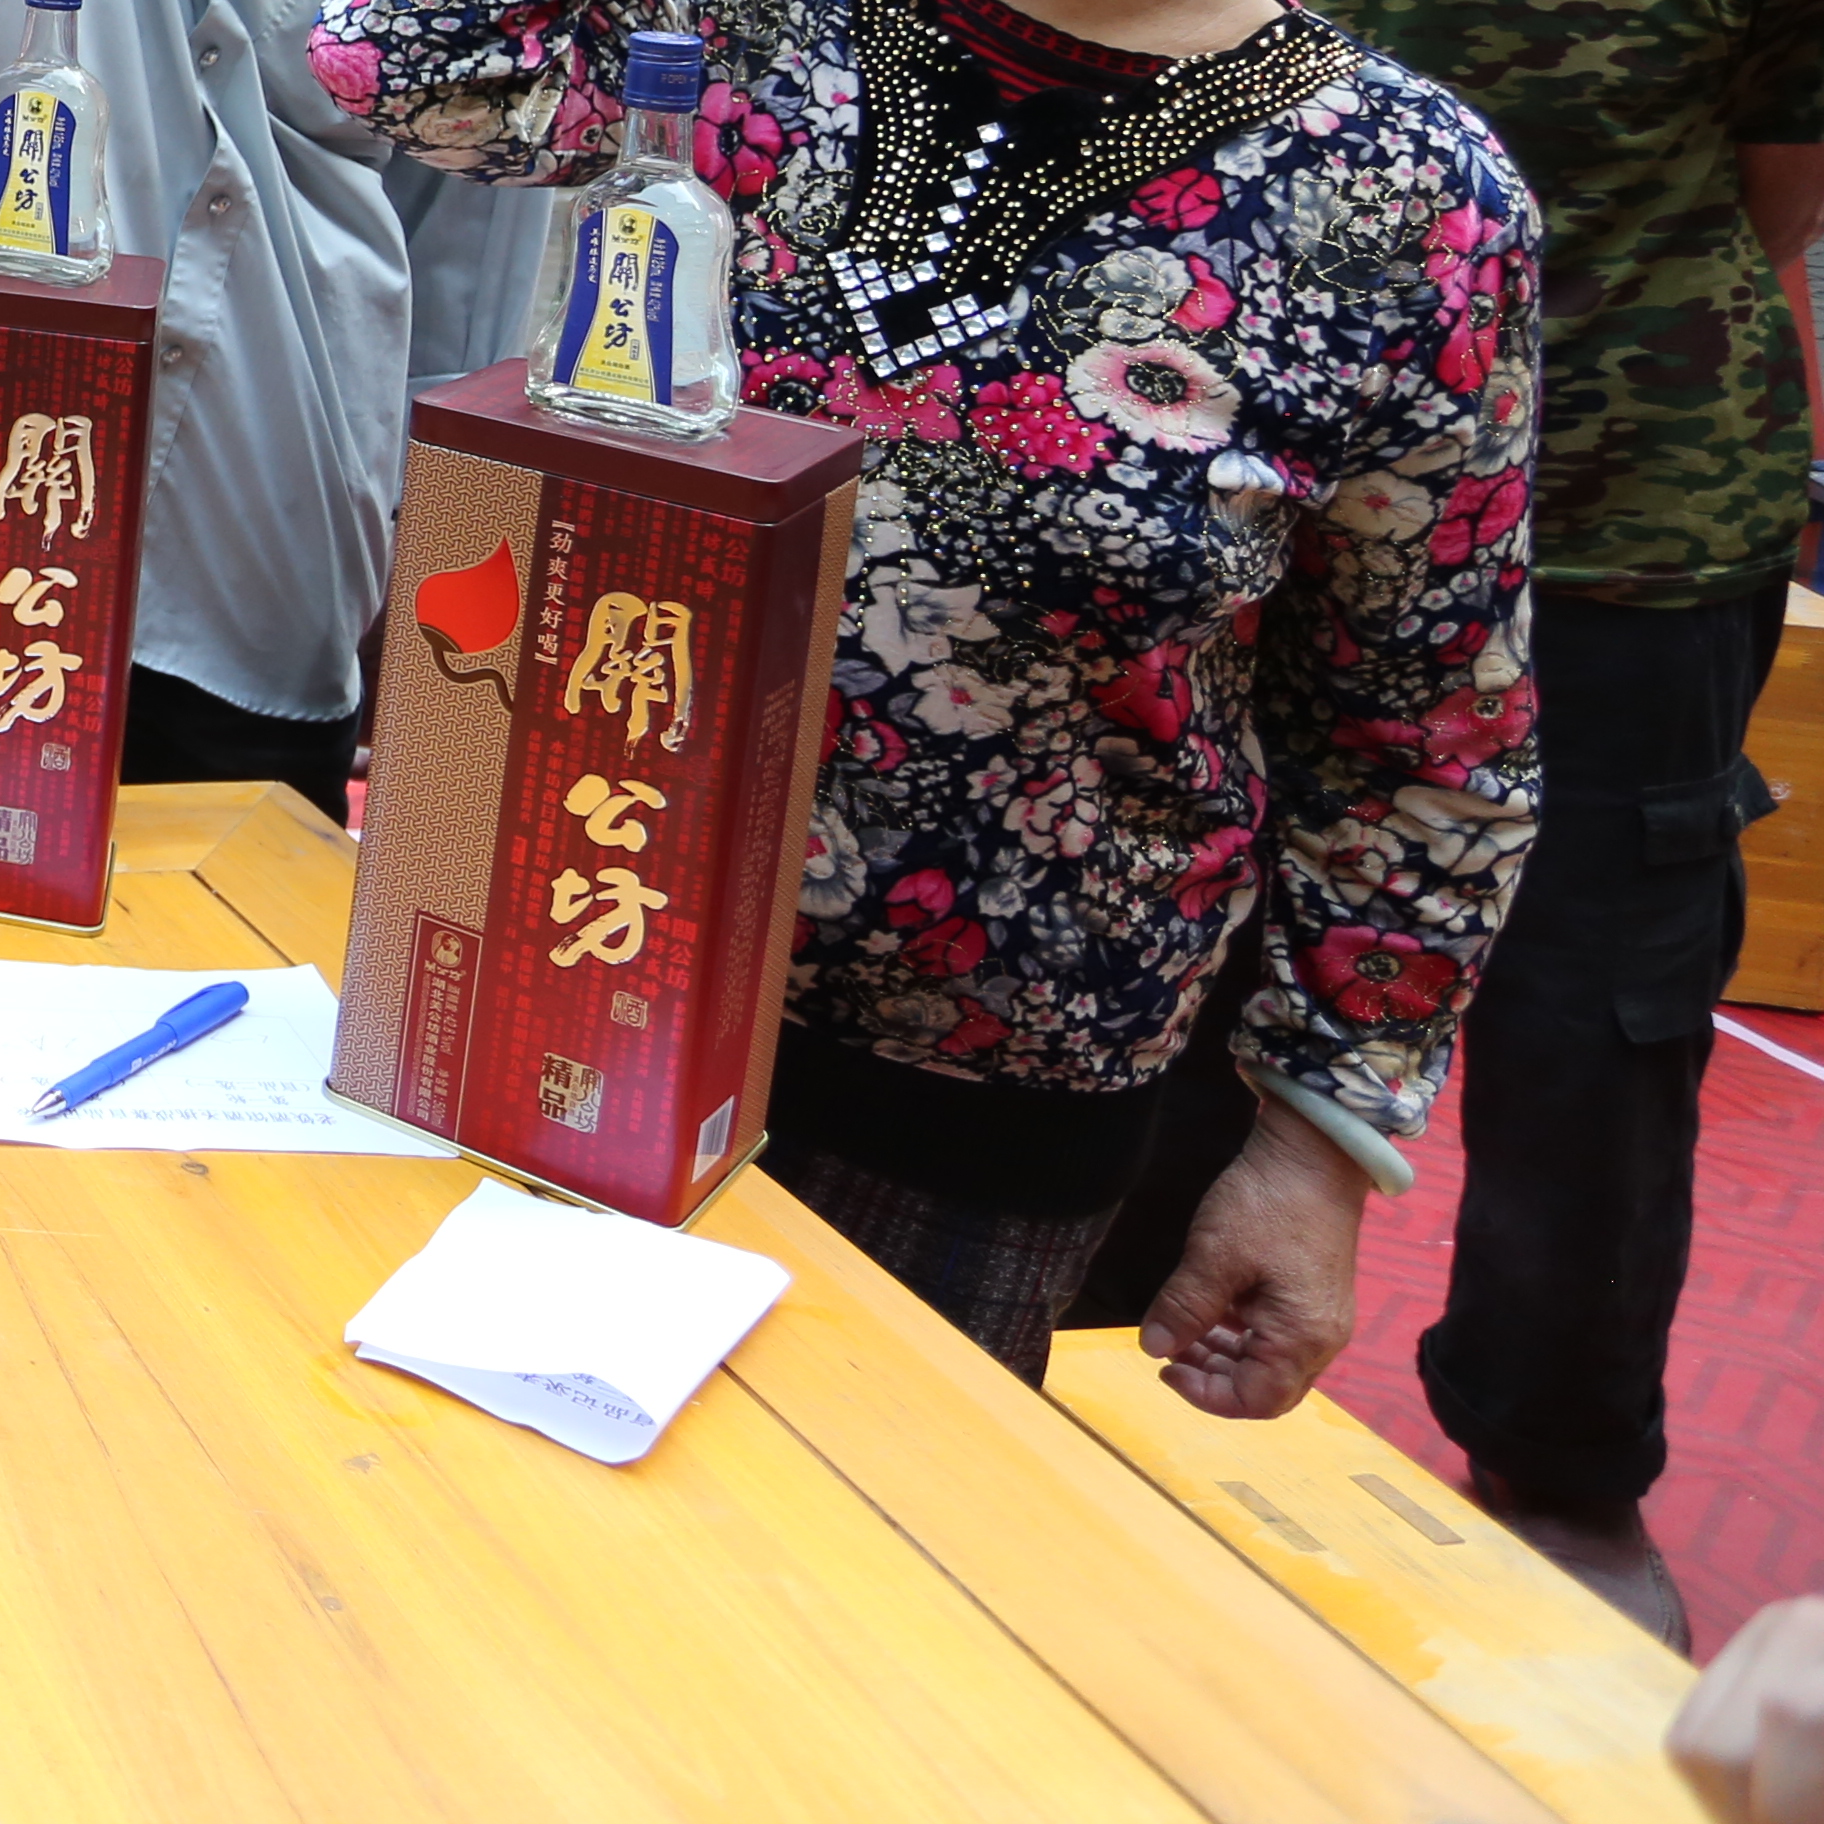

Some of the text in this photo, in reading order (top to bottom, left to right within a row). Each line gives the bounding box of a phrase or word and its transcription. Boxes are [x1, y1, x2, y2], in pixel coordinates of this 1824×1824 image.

[604, 251, 641, 350] 關公坊
[549, 591, 694, 969] 關公坊
